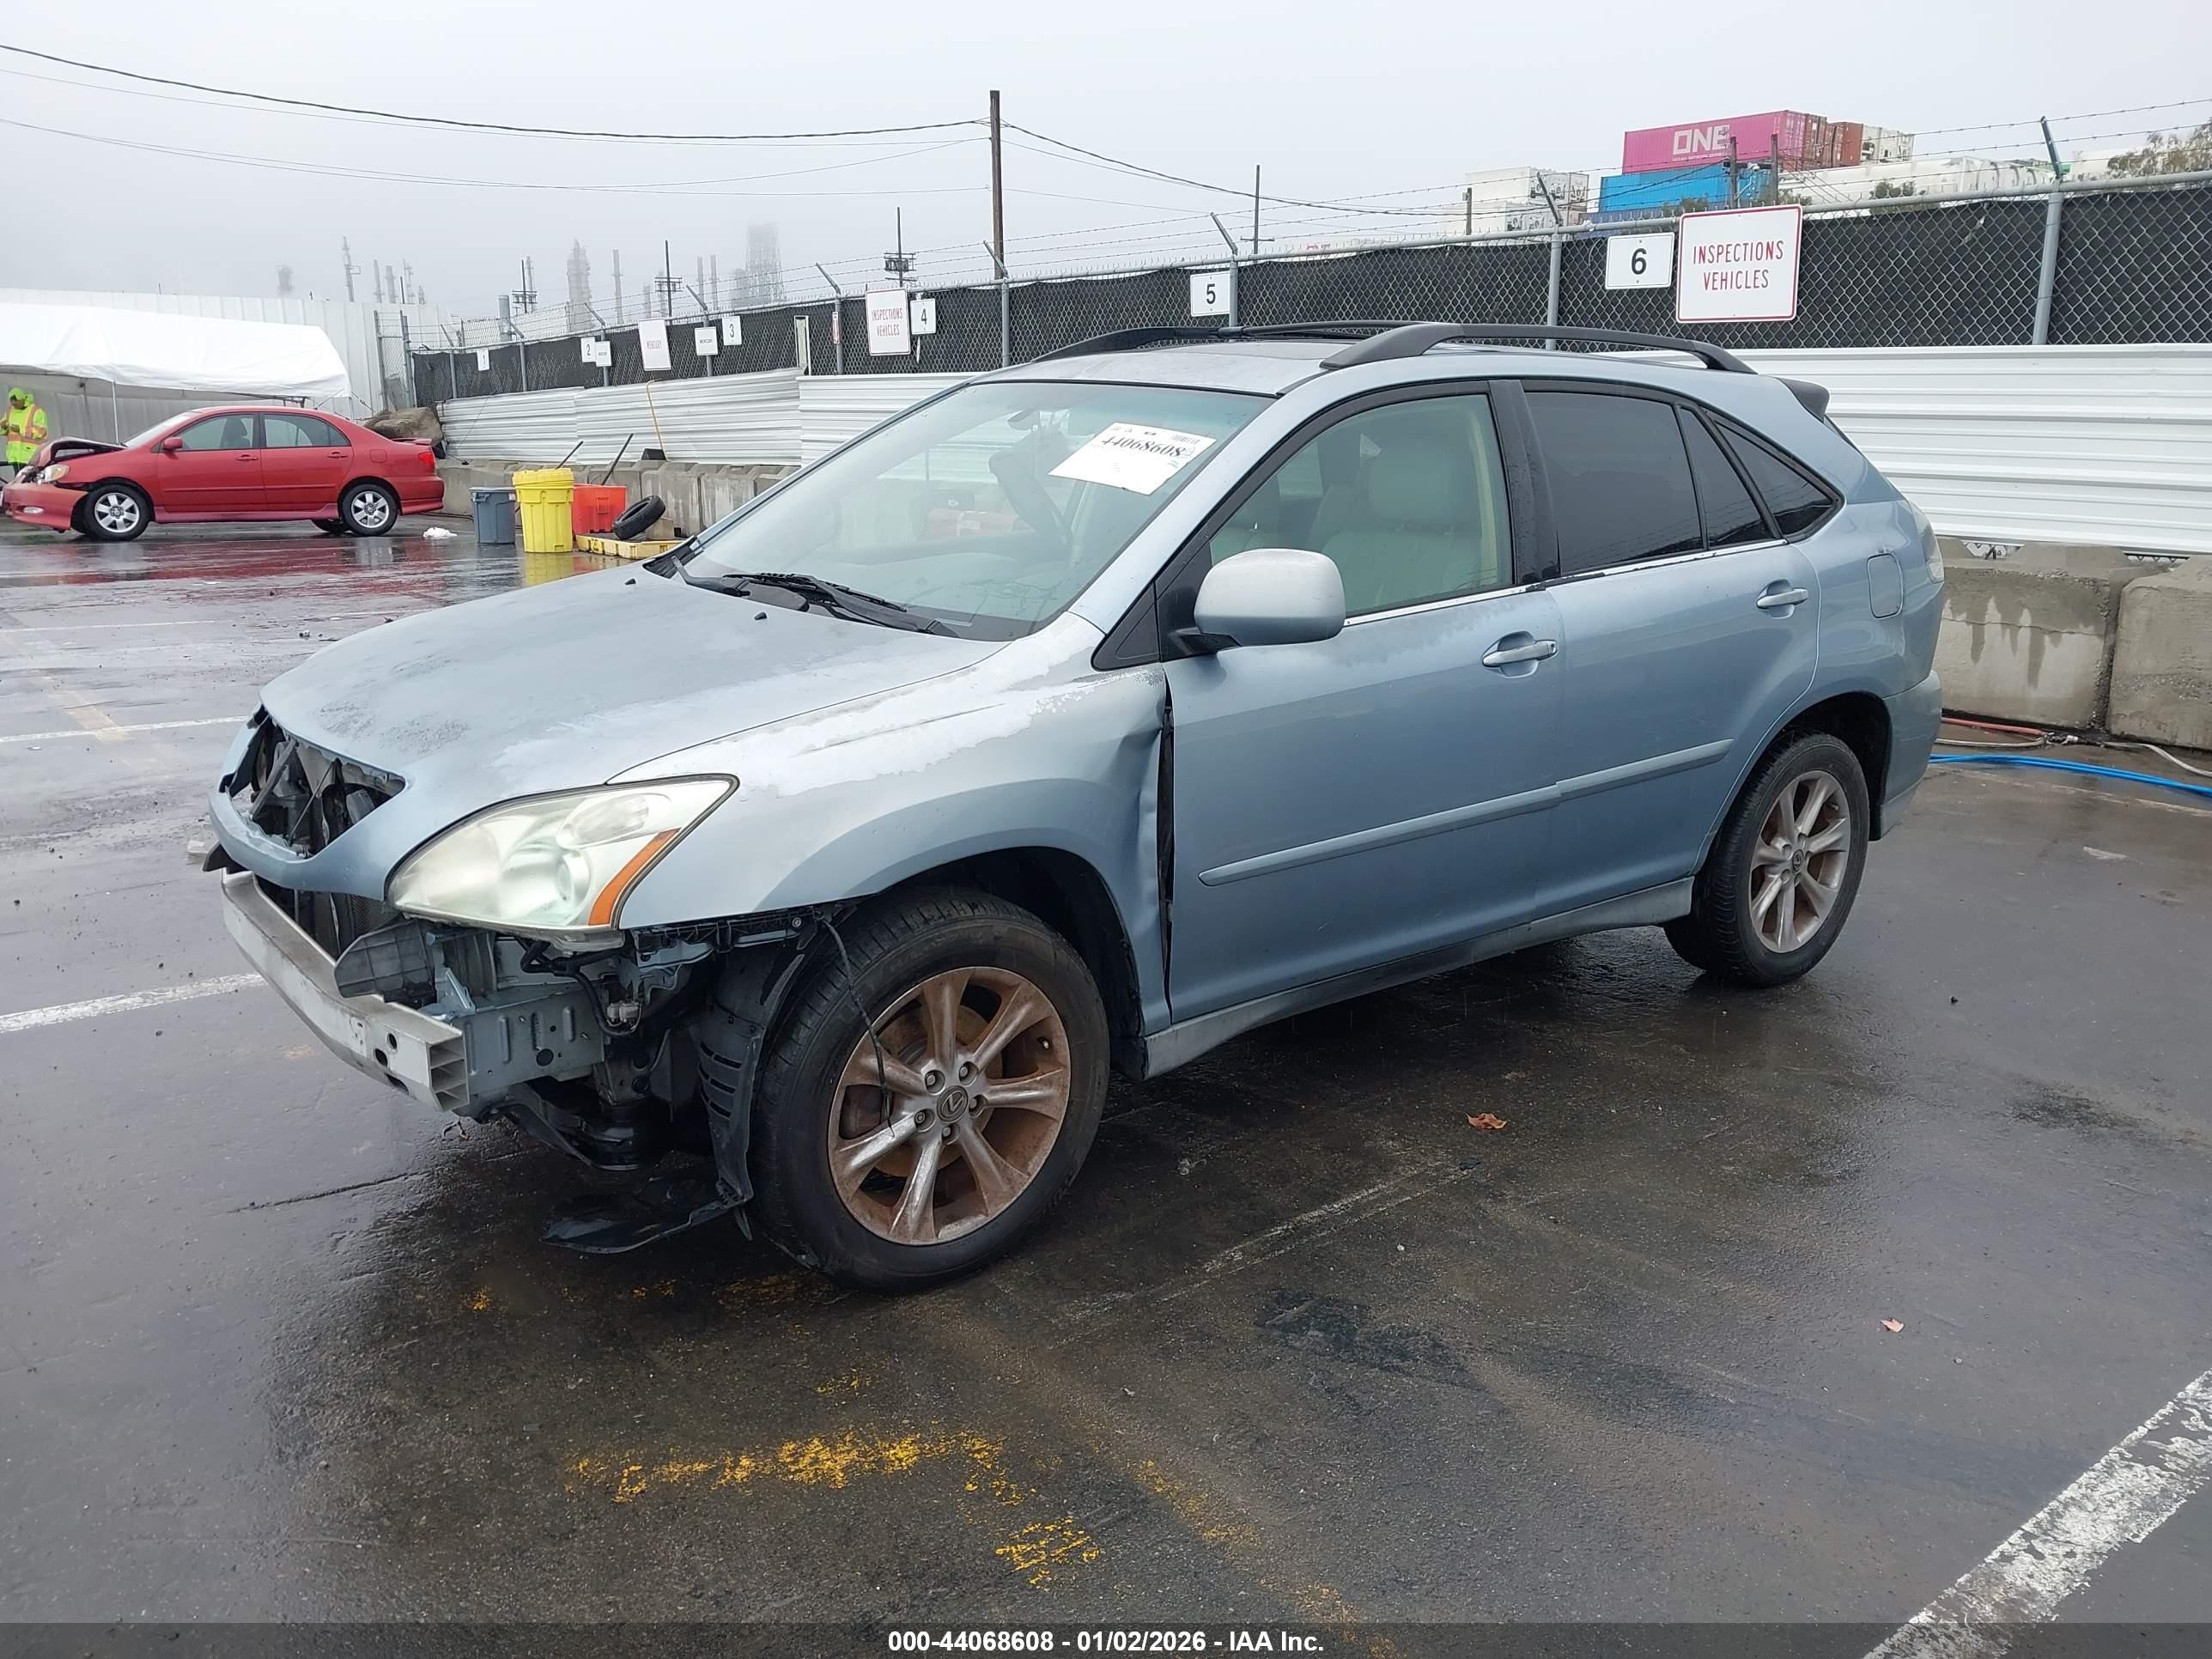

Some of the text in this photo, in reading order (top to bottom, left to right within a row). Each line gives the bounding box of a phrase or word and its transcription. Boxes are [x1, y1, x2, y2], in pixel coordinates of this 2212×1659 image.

[1673, 125, 1730, 155] ONE
[1631, 247, 1648, 276] 6
[1692, 240, 1785, 265] INSPECTIONS
[1703, 269, 1770, 291] VEHICLES
[1205, 283, 1217, 305] 5
[871, 307, 903, 322] INSPECTIONS
[921, 307, 928, 325] 4
[728, 323, 735, 338] 3
[876, 324, 901, 337] VEHICLES
[482, 354, 487, 365] 1
[586, 343, 592, 356] 2
[1101, 434, 1186, 458] 44068608
